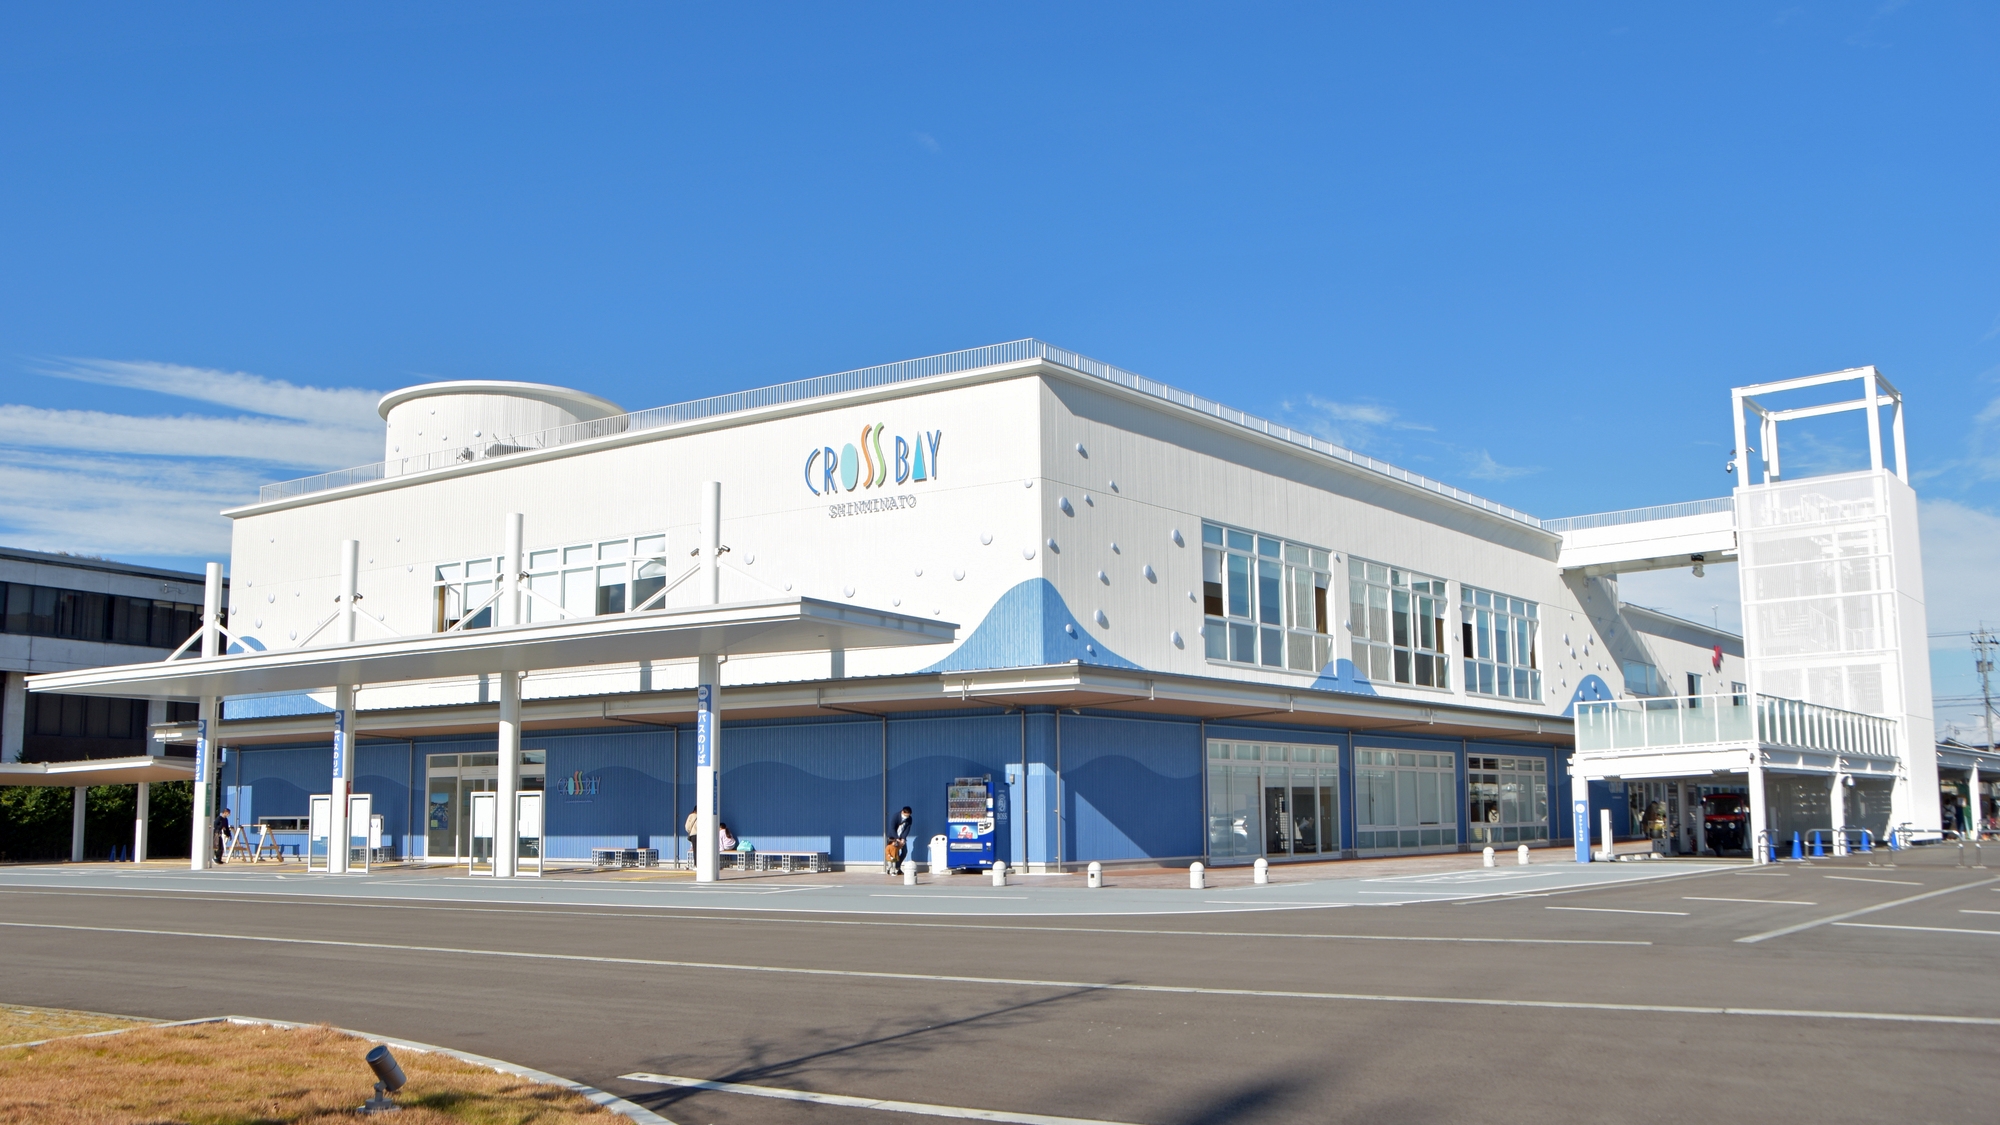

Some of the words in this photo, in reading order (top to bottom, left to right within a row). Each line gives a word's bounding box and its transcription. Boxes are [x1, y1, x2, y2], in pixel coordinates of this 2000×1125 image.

[804, 422, 886, 496] CROSS
[895, 429, 942, 485] BAY
[698, 714, 706, 764] バスのりば
